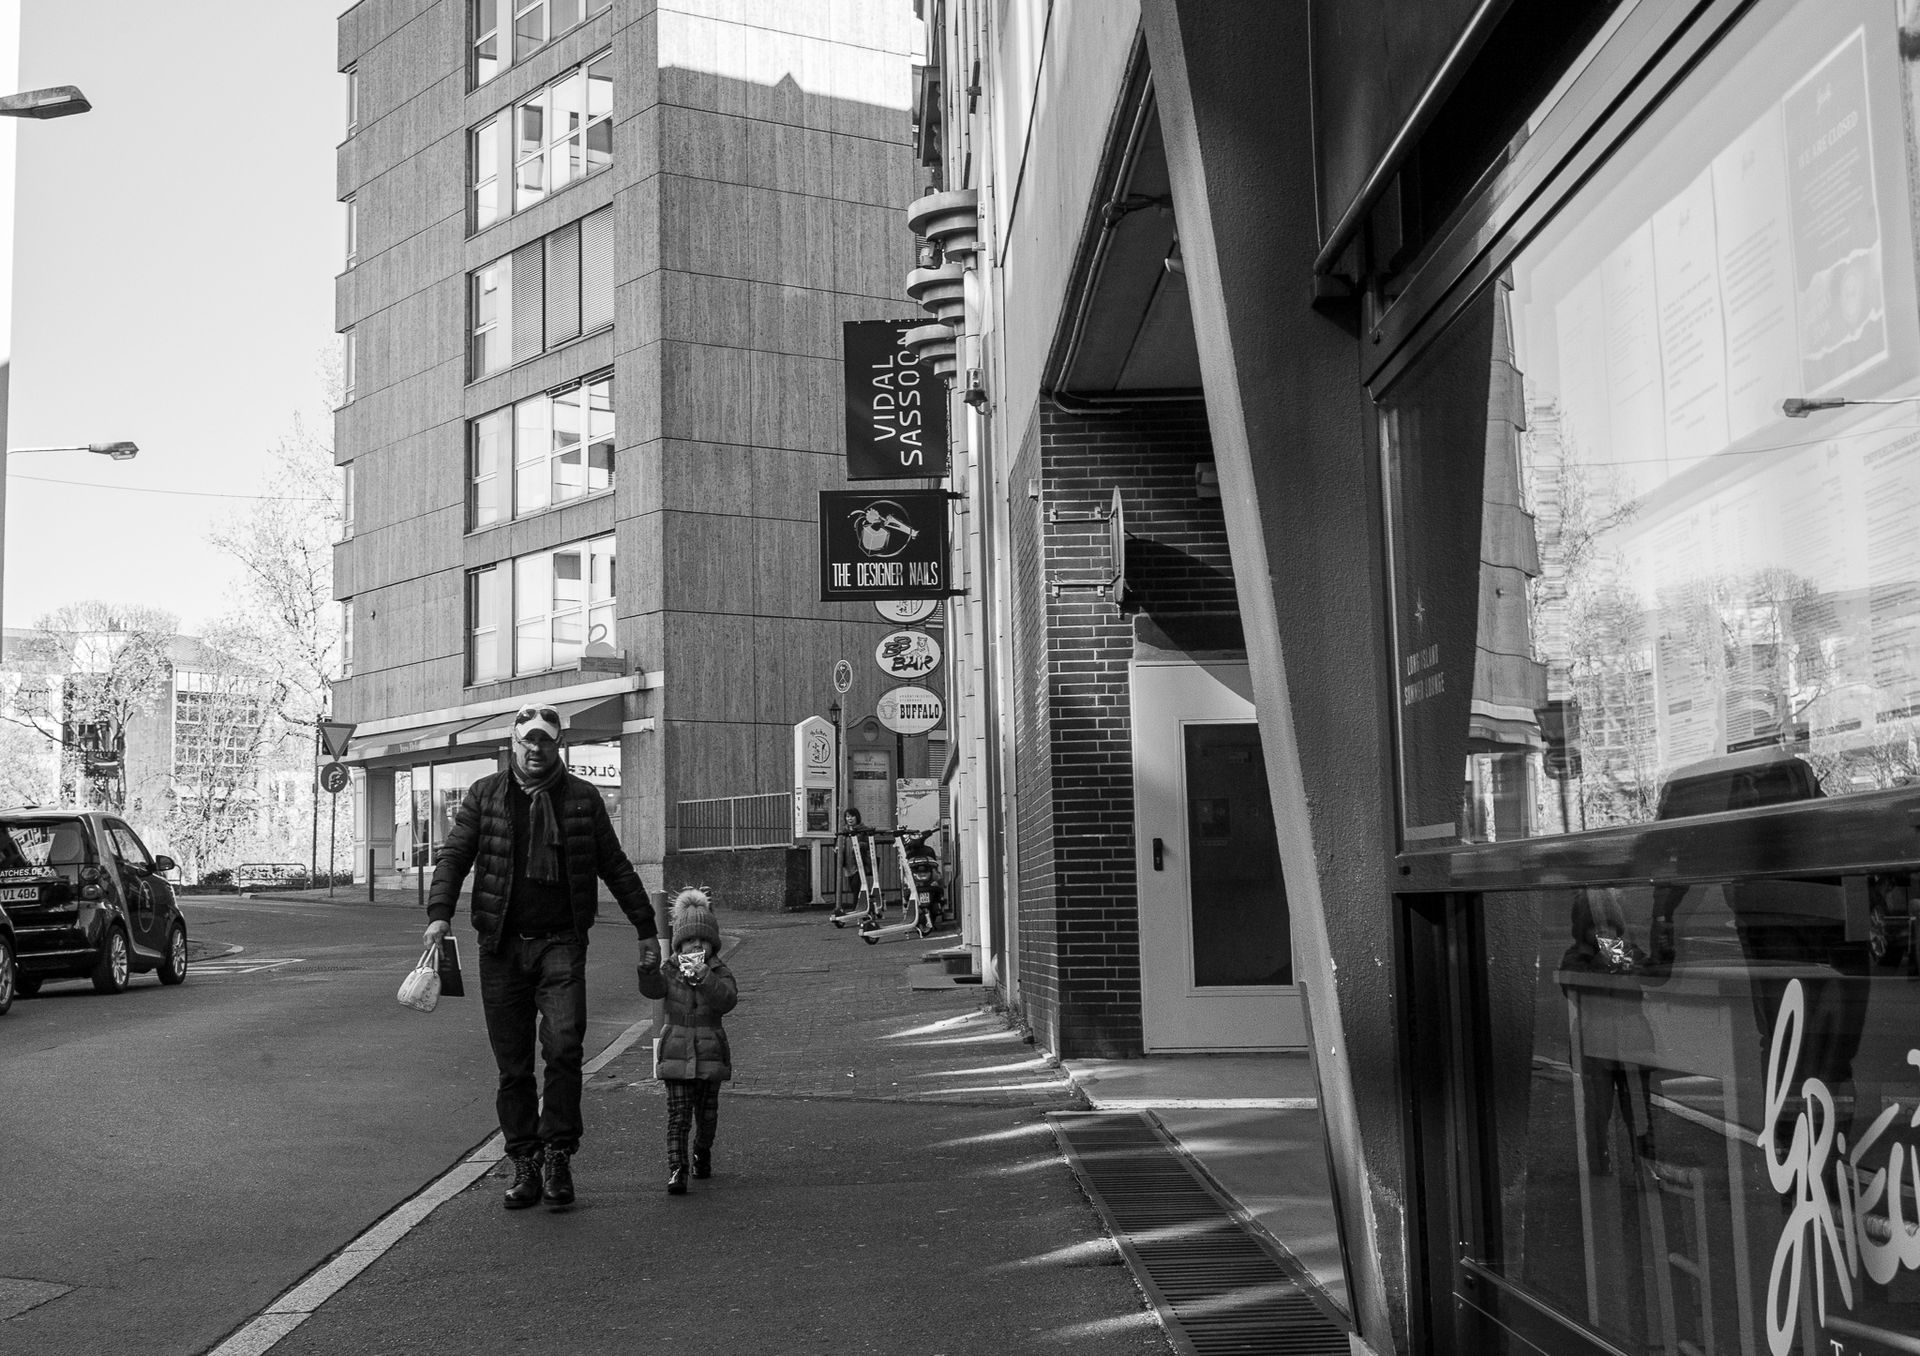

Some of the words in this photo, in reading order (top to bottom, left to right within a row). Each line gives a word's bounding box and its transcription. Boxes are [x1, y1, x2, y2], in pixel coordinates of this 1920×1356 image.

[872, 355, 896, 441] VIDAL
[832, 563, 851, 586] THE
[857, 562, 903, 586] DESIGNER
[909, 562, 938, 586] NAILS
[900, 704, 940, 719] BUFFALO
